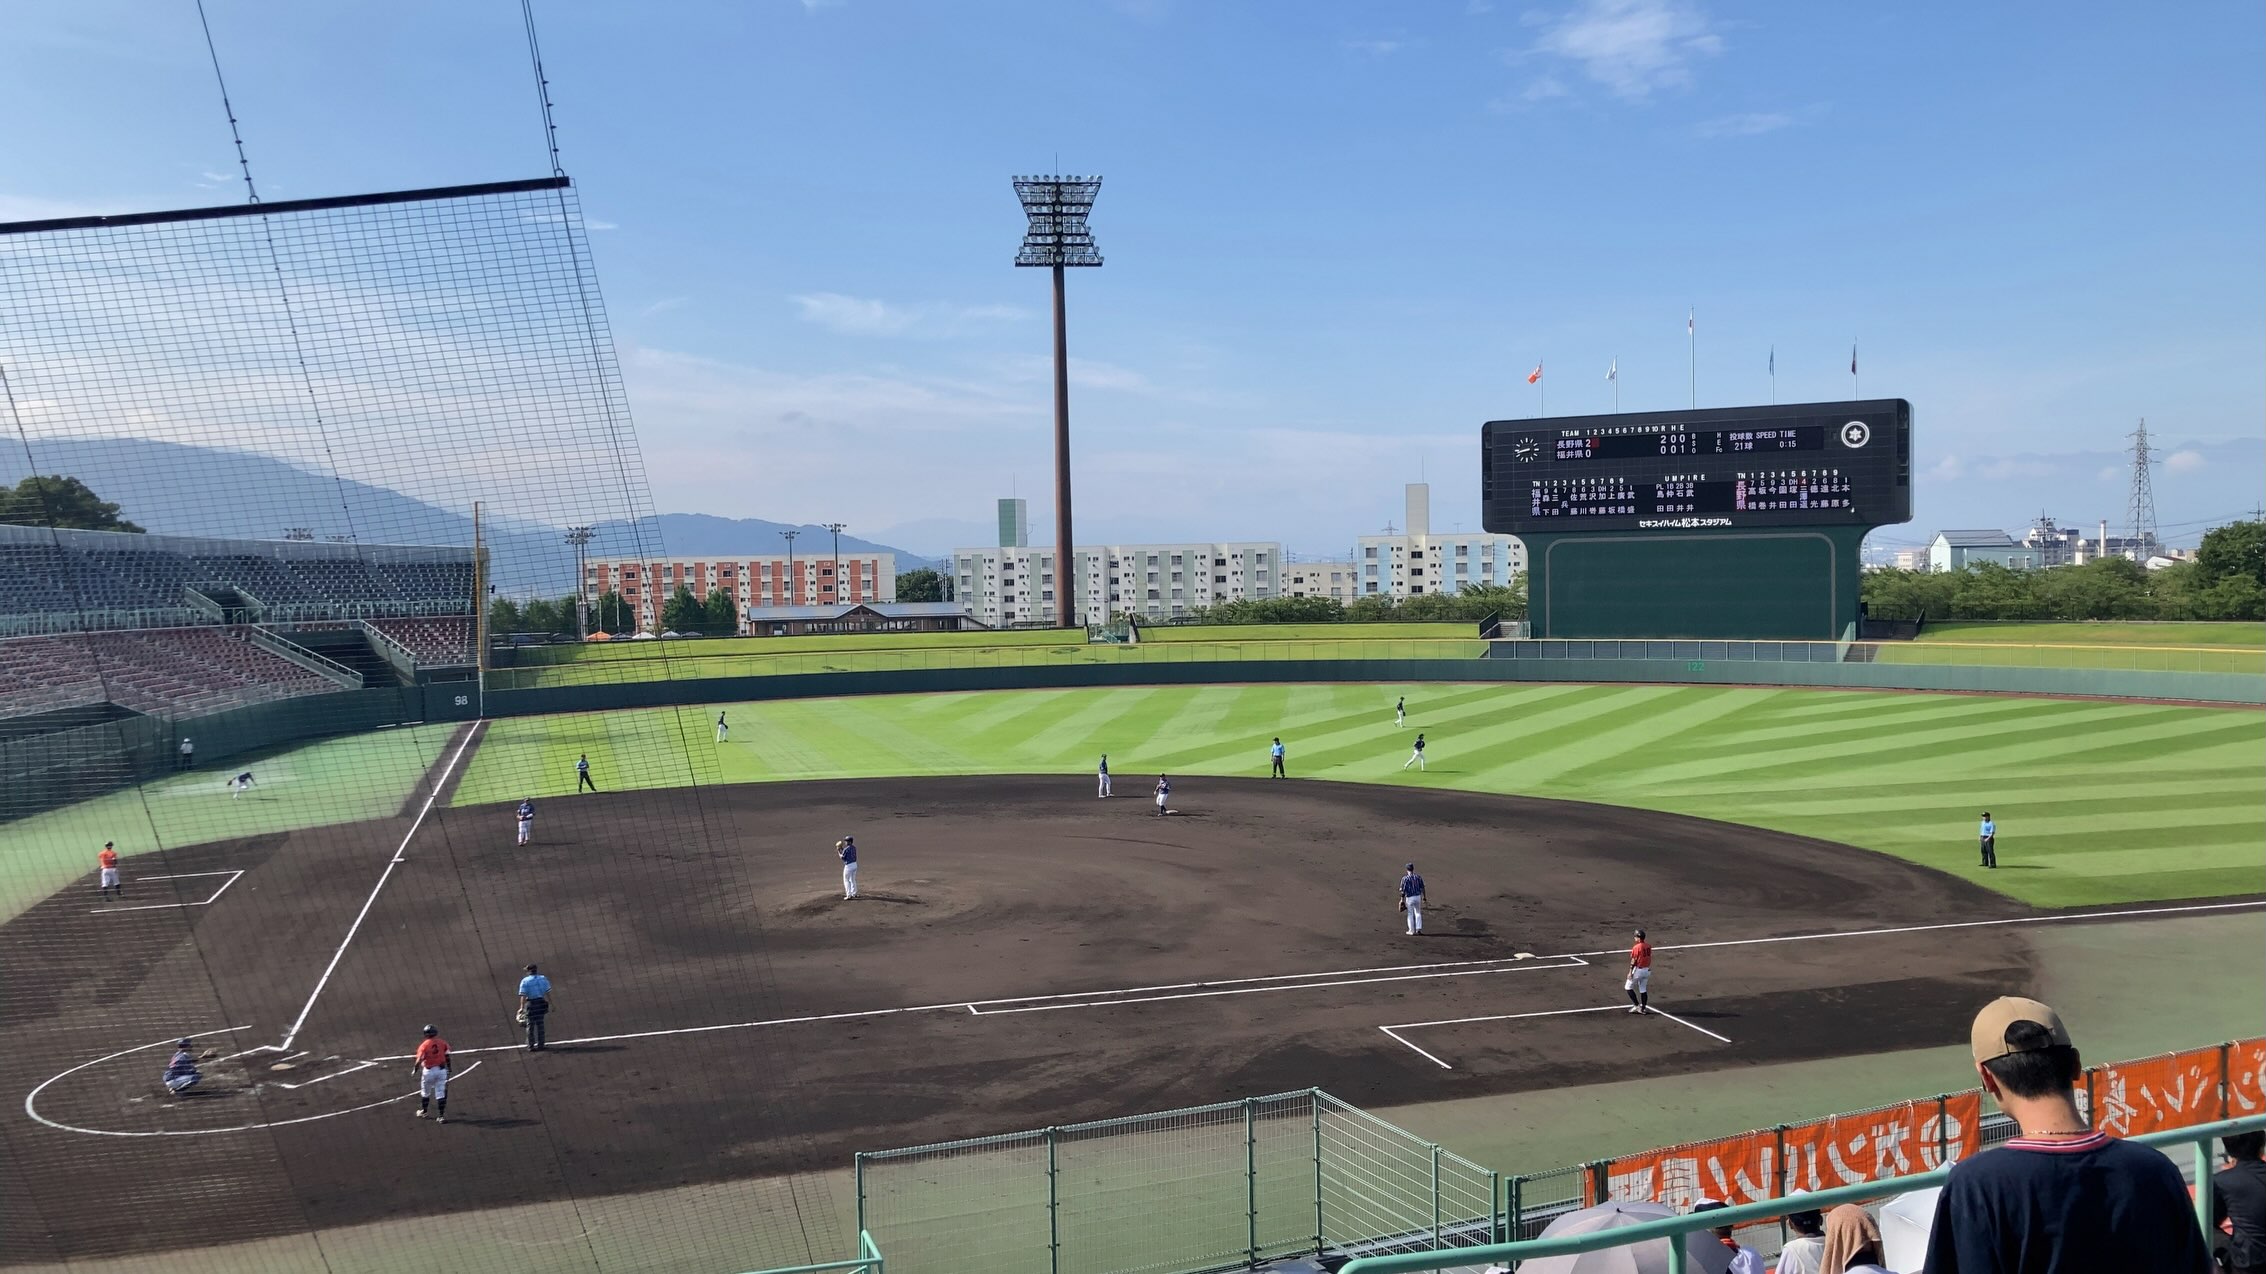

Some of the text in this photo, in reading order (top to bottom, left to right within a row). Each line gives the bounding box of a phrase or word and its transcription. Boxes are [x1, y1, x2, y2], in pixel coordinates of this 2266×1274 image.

[1557, 434, 1685, 449] 長野県 2 2 0 0
[1730, 432, 1753, 440] 投球数
[1557, 445, 1684, 459] 福井県 0 0 0 1
[1736, 481, 1746, 509] 長野県
[1532, 489, 1541, 516] 福井県
[1639, 518, 1732, 528] セキスイハイム松本スタジアム
[1688, 661, 1704, 671] 122
[455, 696, 468, 705] 98
